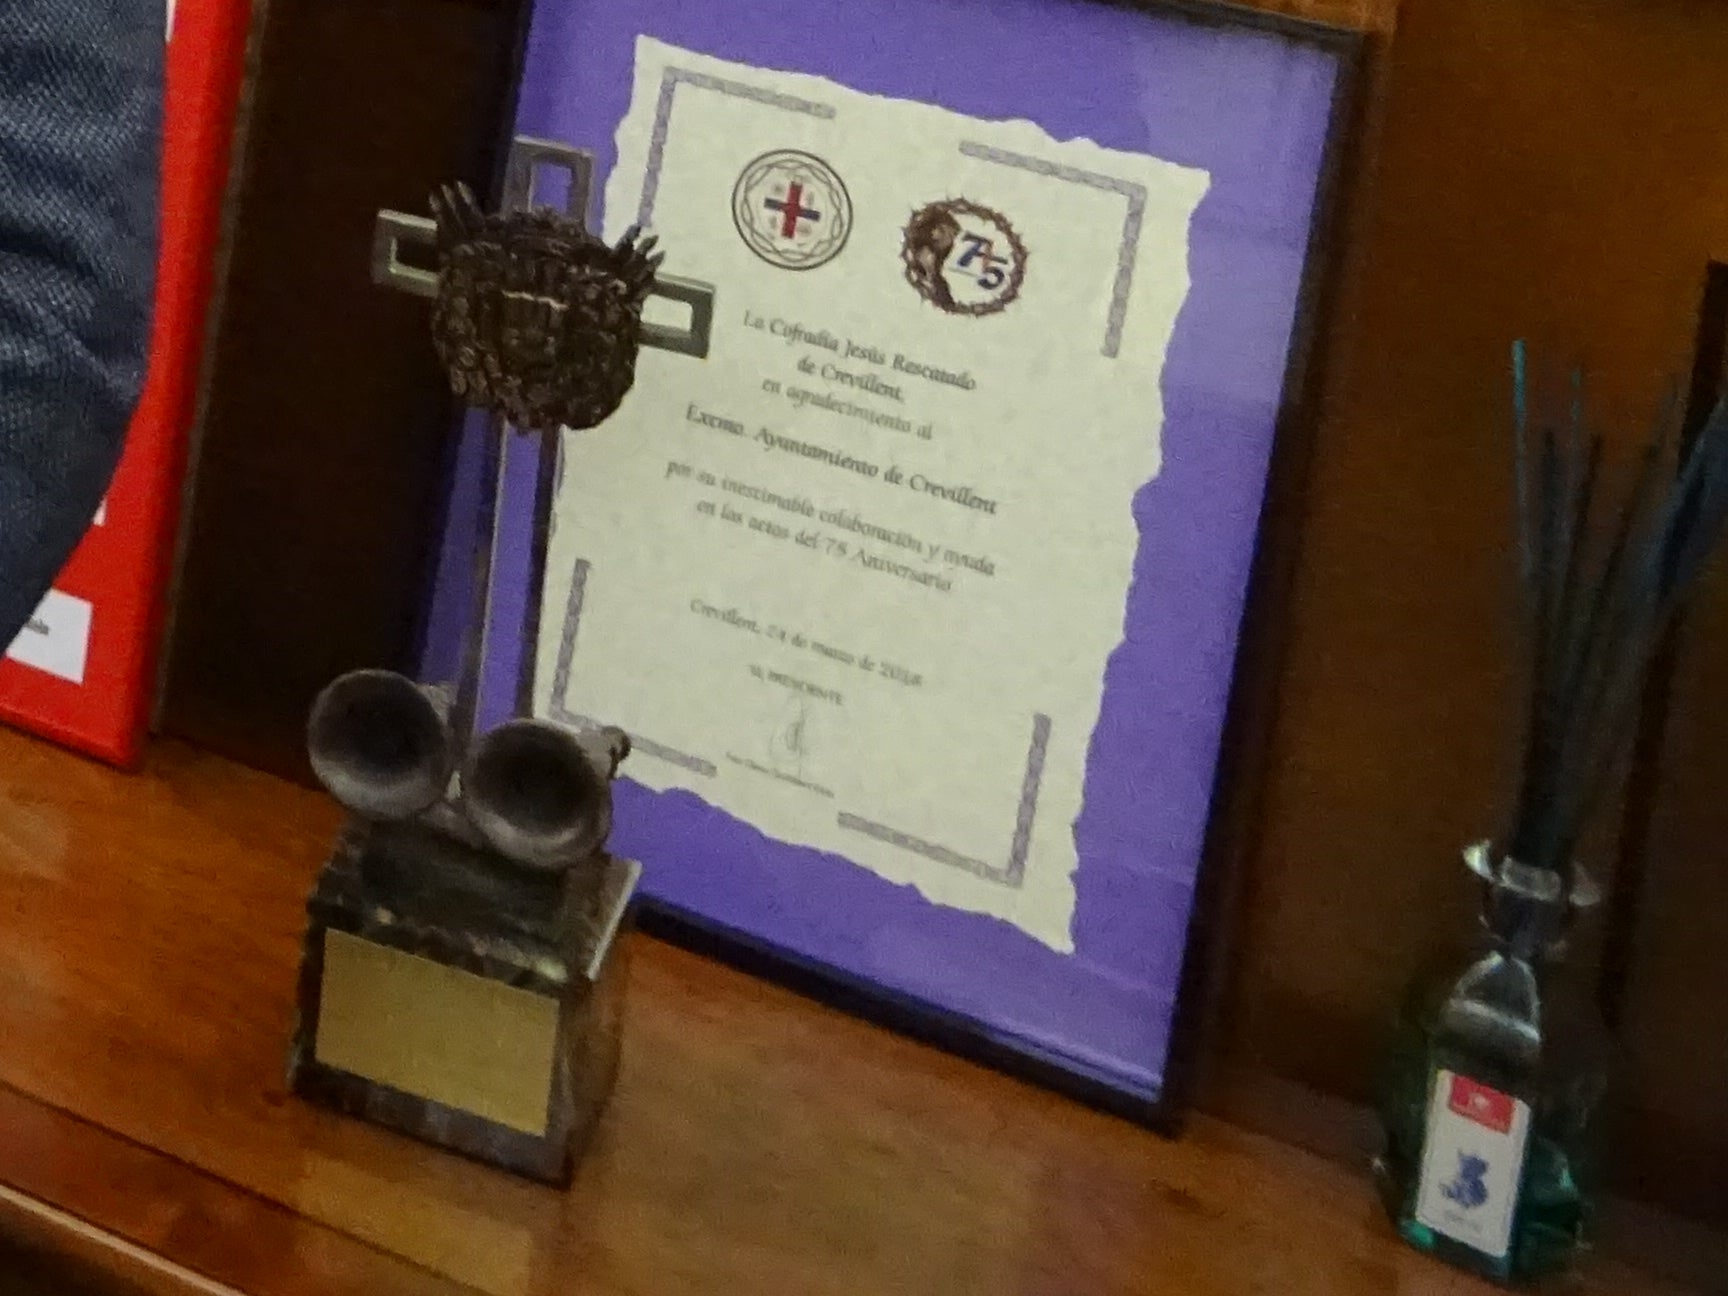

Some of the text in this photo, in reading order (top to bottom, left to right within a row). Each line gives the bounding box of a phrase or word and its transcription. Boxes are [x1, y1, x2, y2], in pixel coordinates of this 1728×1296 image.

[744, 310, 976, 390] La Cofradía Jesús Rescatado
[797, 356, 815, 375] de
[762, 379, 932, 440] en agradecimiento al
[753, 427, 878, 477] Ayuntamiento
[884, 465, 903, 484] de
[909, 474, 996, 514] Crevillent
[665, 461, 995, 576] por su inestimable colaboración y ayuda
[697, 500, 716, 516] en
[720, 503, 743, 524] las
[748, 517, 790, 539] actos
[795, 529, 820, 549] del
[851, 548, 952, 592] Aniversario
[791, 632, 808, 649] de
[858, 654, 875, 672] de
